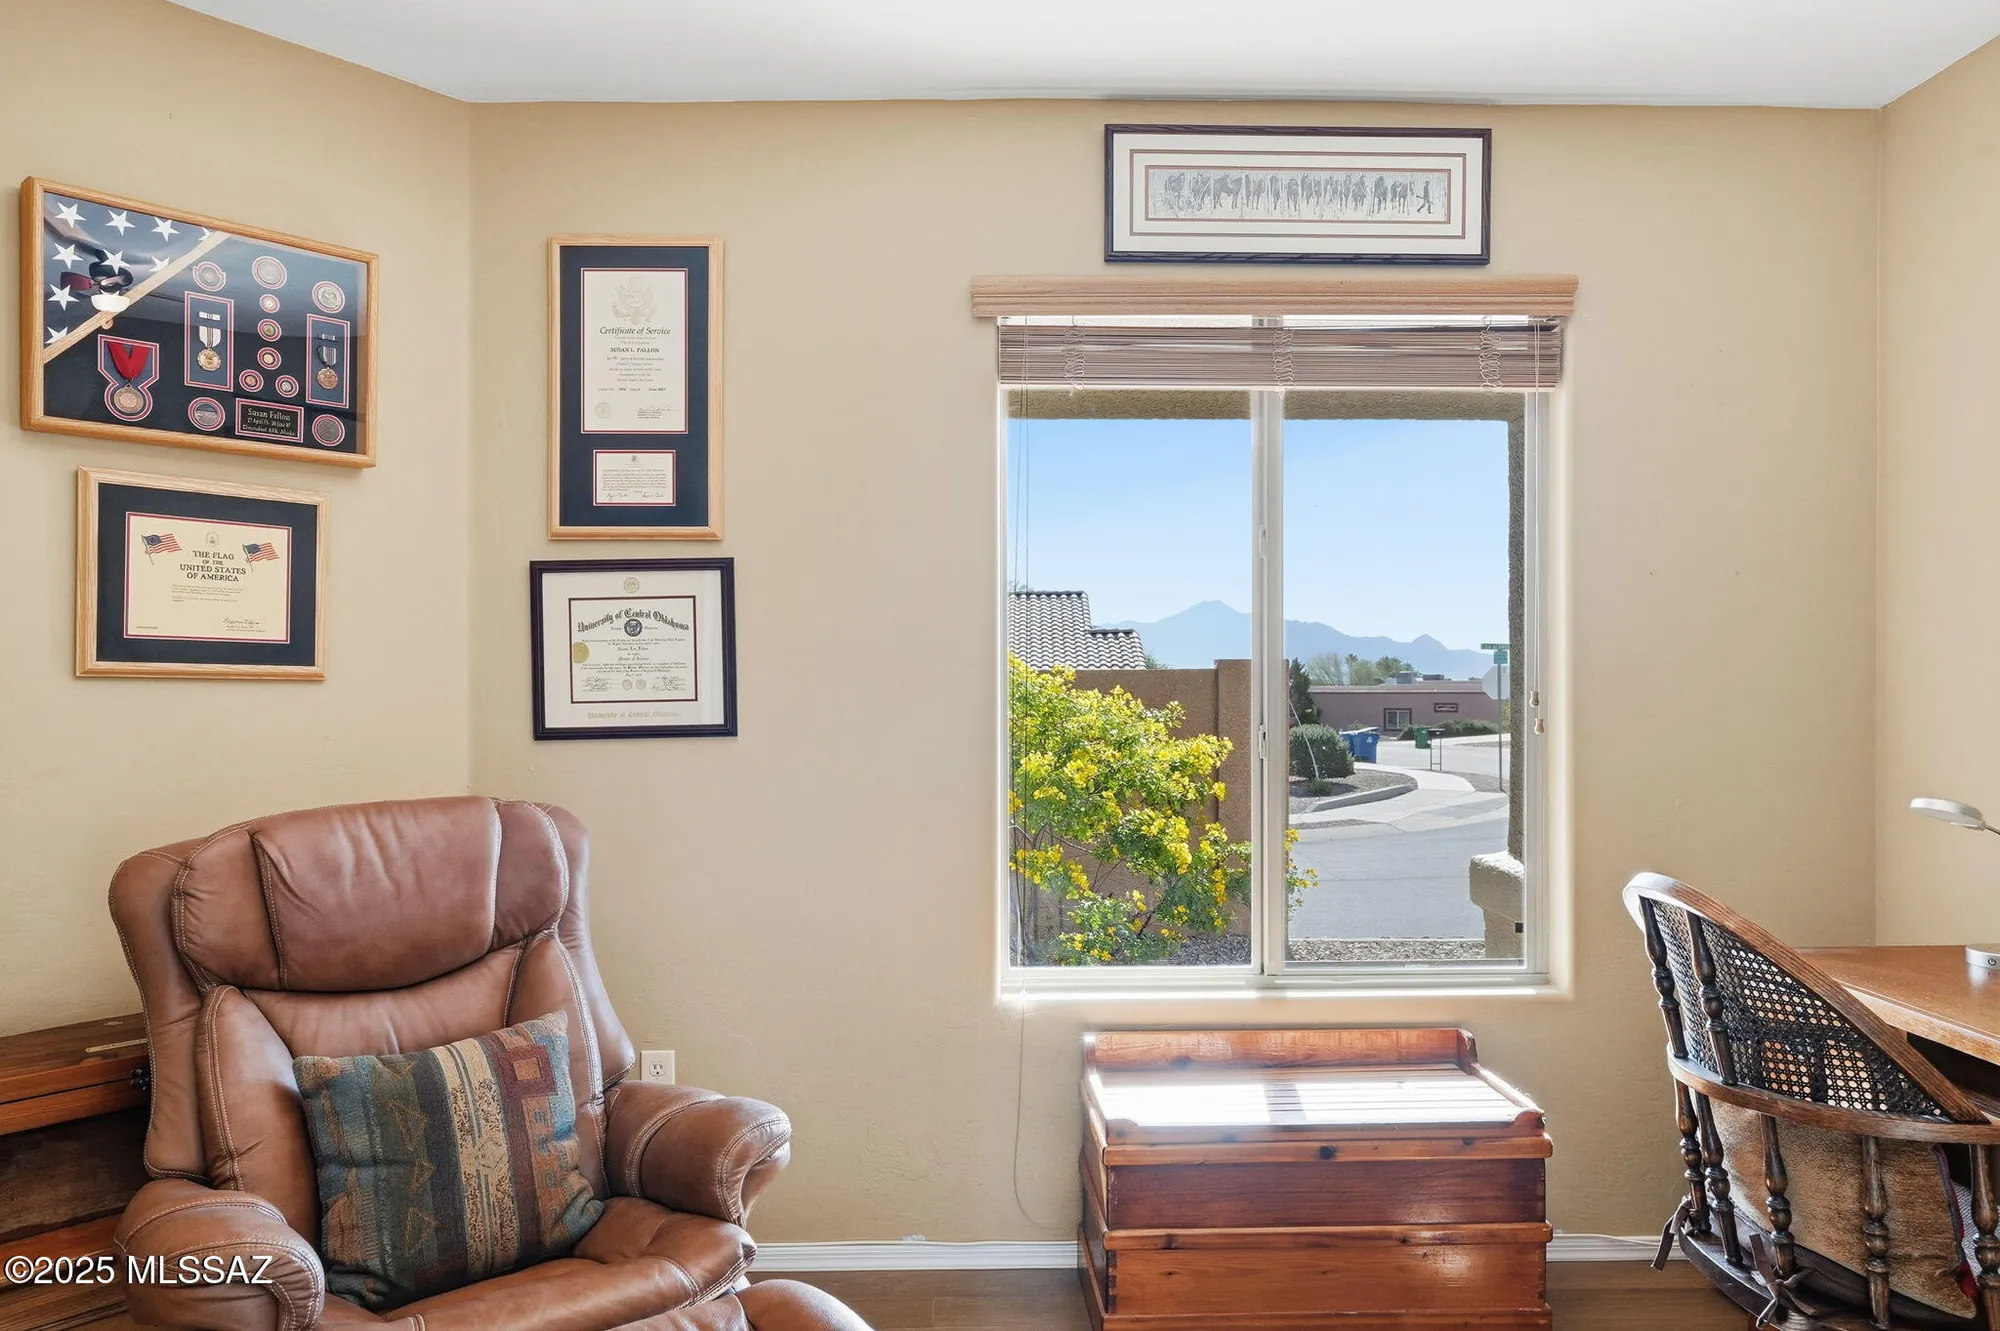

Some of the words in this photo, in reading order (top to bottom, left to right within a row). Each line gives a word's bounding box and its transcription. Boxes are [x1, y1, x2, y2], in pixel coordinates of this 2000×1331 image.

[599, 326, 636, 336] Certificate
[636, 326, 645, 335] of
[645, 326, 672, 335] Service
[247, 408, 268, 418] Susan
[269, 410, 291, 422] Fallon
[192, 550, 211, 559] THE
[212, 552, 235, 561] FLAG
[179, 563, 213, 573] UNITED
[214, 566, 247, 575] STATES
[186, 571, 199, 580] OF
[200, 573, 240, 582] AMERICA
[577, 613, 614, 633] University
[614, 610, 624, 620] of
[624, 607, 652, 620] Central
[652, 610, 690, 631] Oklahoma
